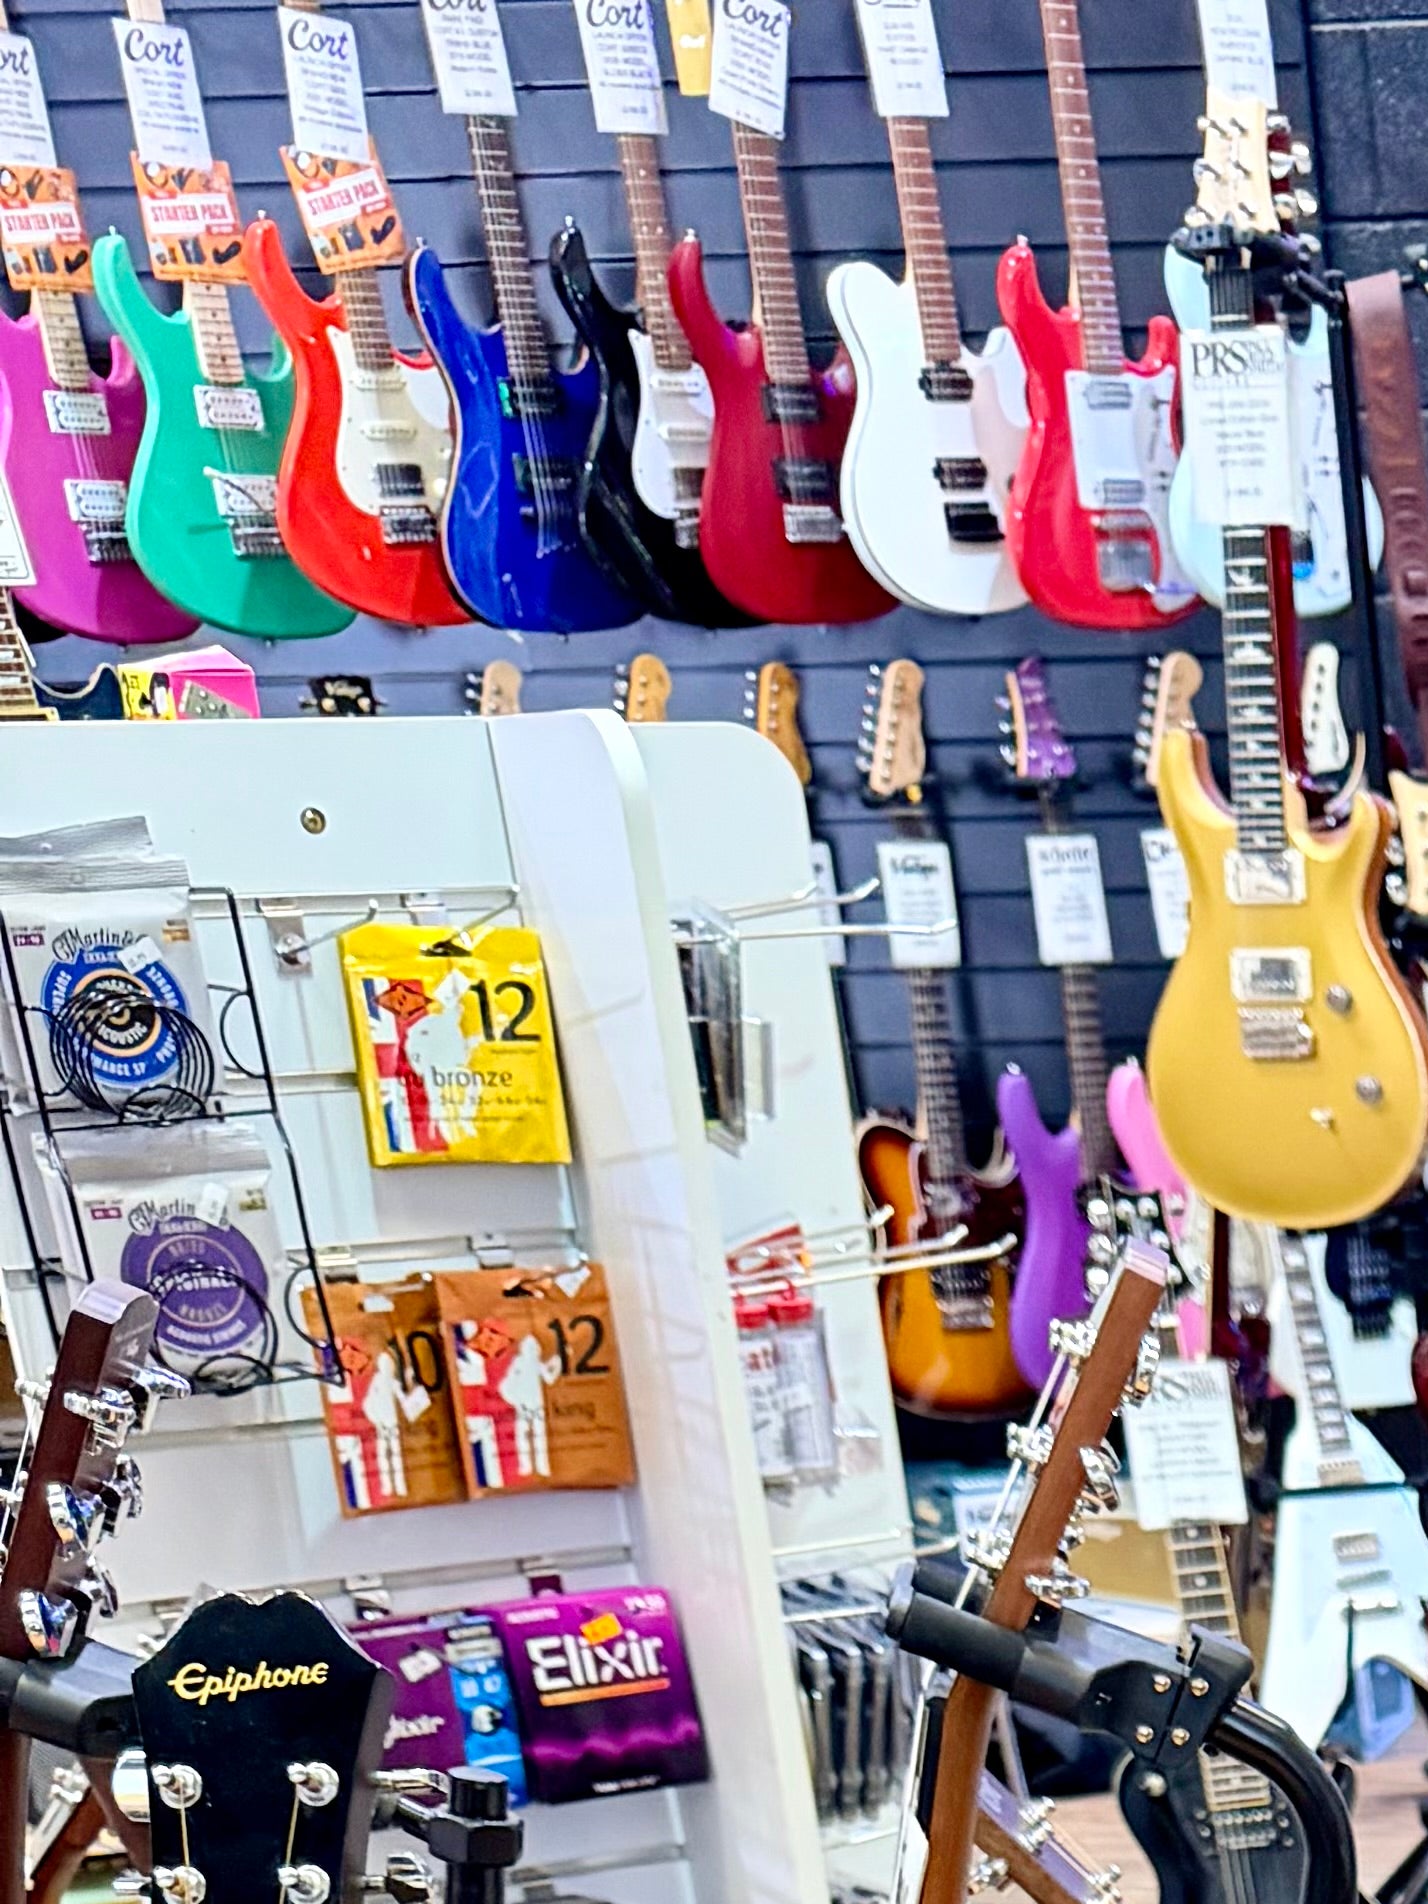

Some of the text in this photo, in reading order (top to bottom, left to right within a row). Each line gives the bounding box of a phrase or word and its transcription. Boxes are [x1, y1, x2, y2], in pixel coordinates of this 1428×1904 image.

[124, 28, 184, 66] Cort
[288, 18, 348, 60] Cort
[0, 47, 30, 75] ort
[149, 203, 229, 222] STARTER PACK
[307, 178, 381, 216] STARTER PACK
[6, 212, 77, 231] STARTER PACK
[1190, 340, 1248, 377] PRS
[470, 979, 541, 1041] 12
[431, 1065, 513, 1088] bronze
[389, 1330, 443, 1393] 10
[547, 1314, 609, 1376] 12
[525, 1628, 665, 1692] Elixir
[167, 1661, 330, 1705] Epiphone
